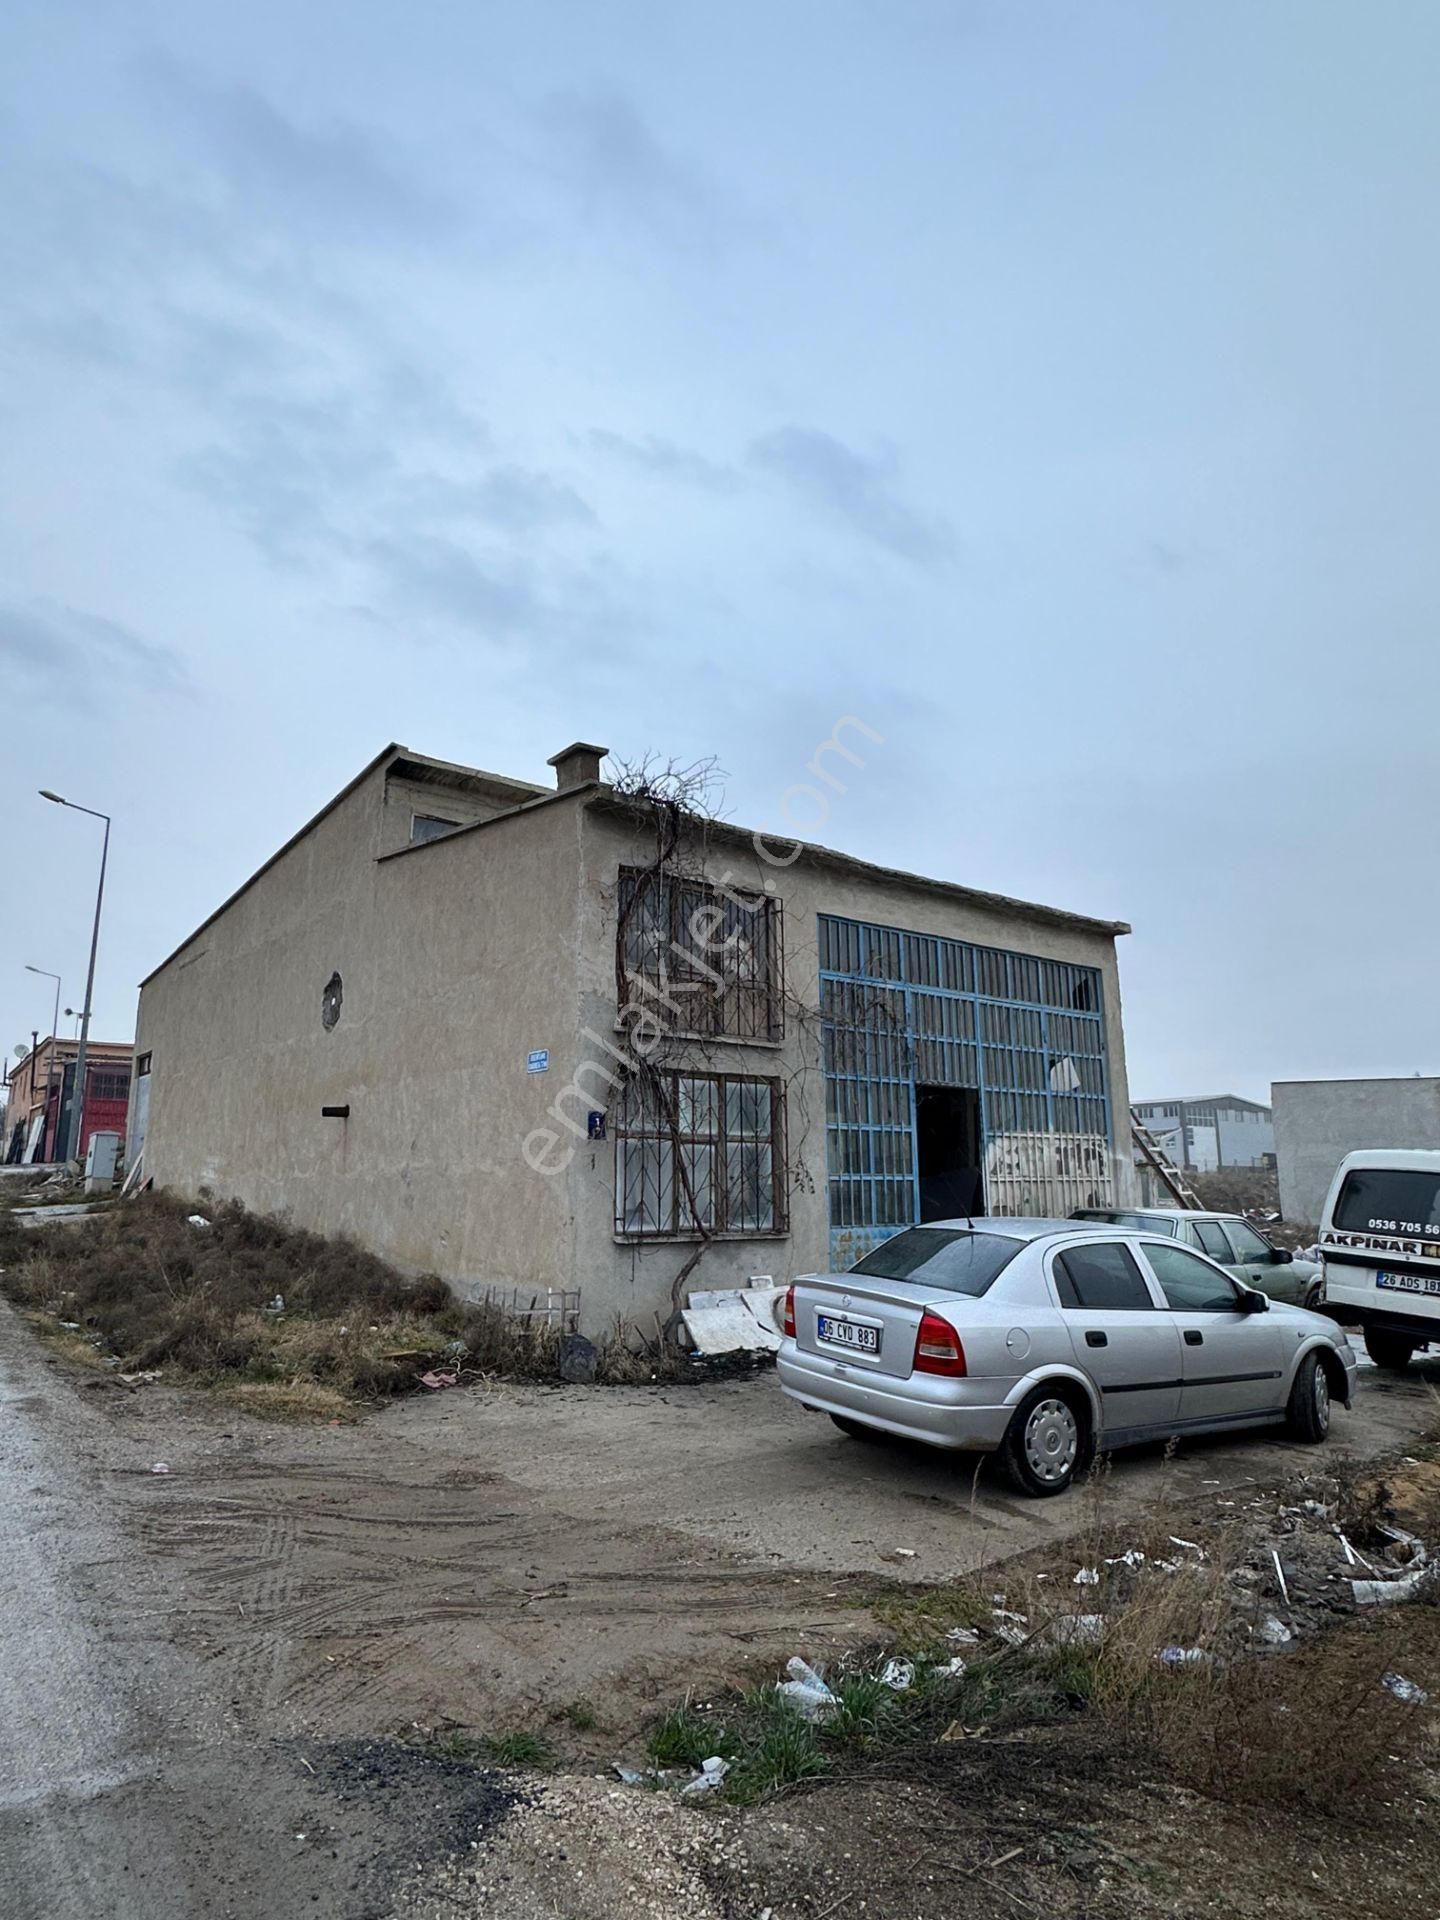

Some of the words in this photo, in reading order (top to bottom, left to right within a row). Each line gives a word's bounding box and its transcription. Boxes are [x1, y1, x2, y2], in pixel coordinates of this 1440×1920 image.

[1368, 1219, 1397, 1231] 0536
[1400, 1221, 1422, 1233] 705
[1323, 1233, 1418, 1254] AKPINAR
[1383, 1274, 1396, 1286] 26
[1400, 1276, 1420, 1289] ADS
[824, 1320, 834, 1336] 06
[858, 1328, 875, 1346] 883
